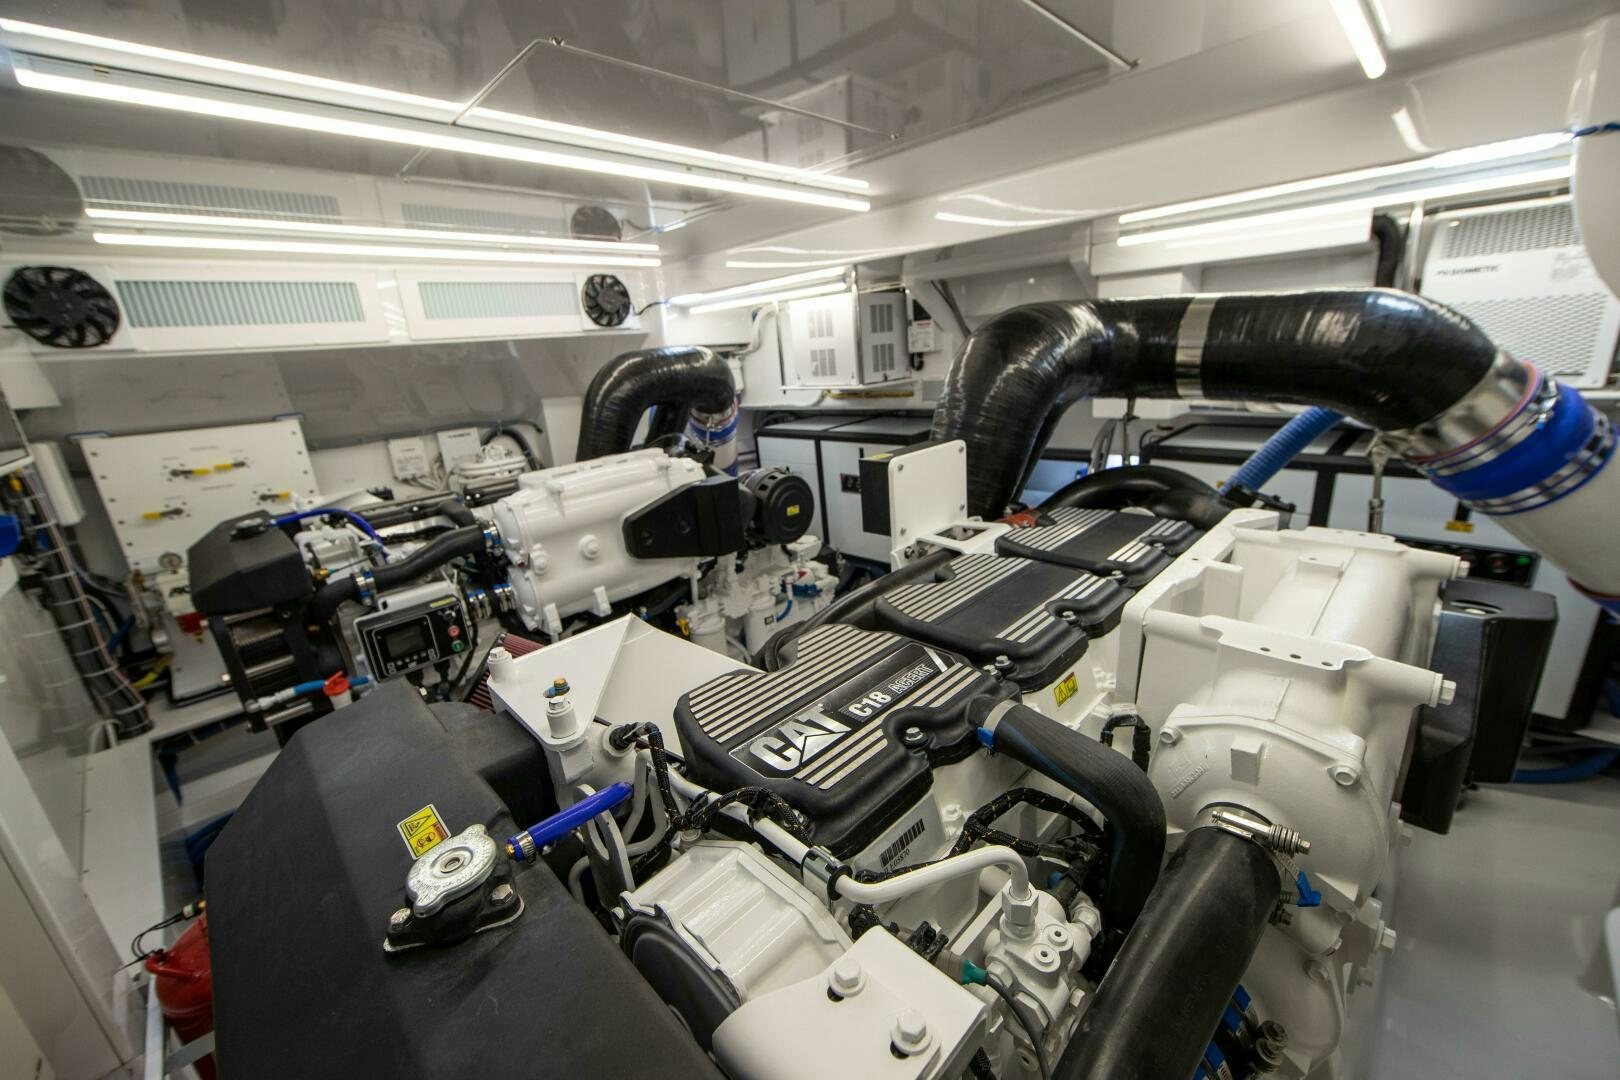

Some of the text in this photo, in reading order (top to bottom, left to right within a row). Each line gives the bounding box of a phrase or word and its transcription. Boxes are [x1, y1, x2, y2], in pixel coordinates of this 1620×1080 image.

[848, 664, 934, 717] C18 ACERT
[750, 707, 852, 771] CAT
